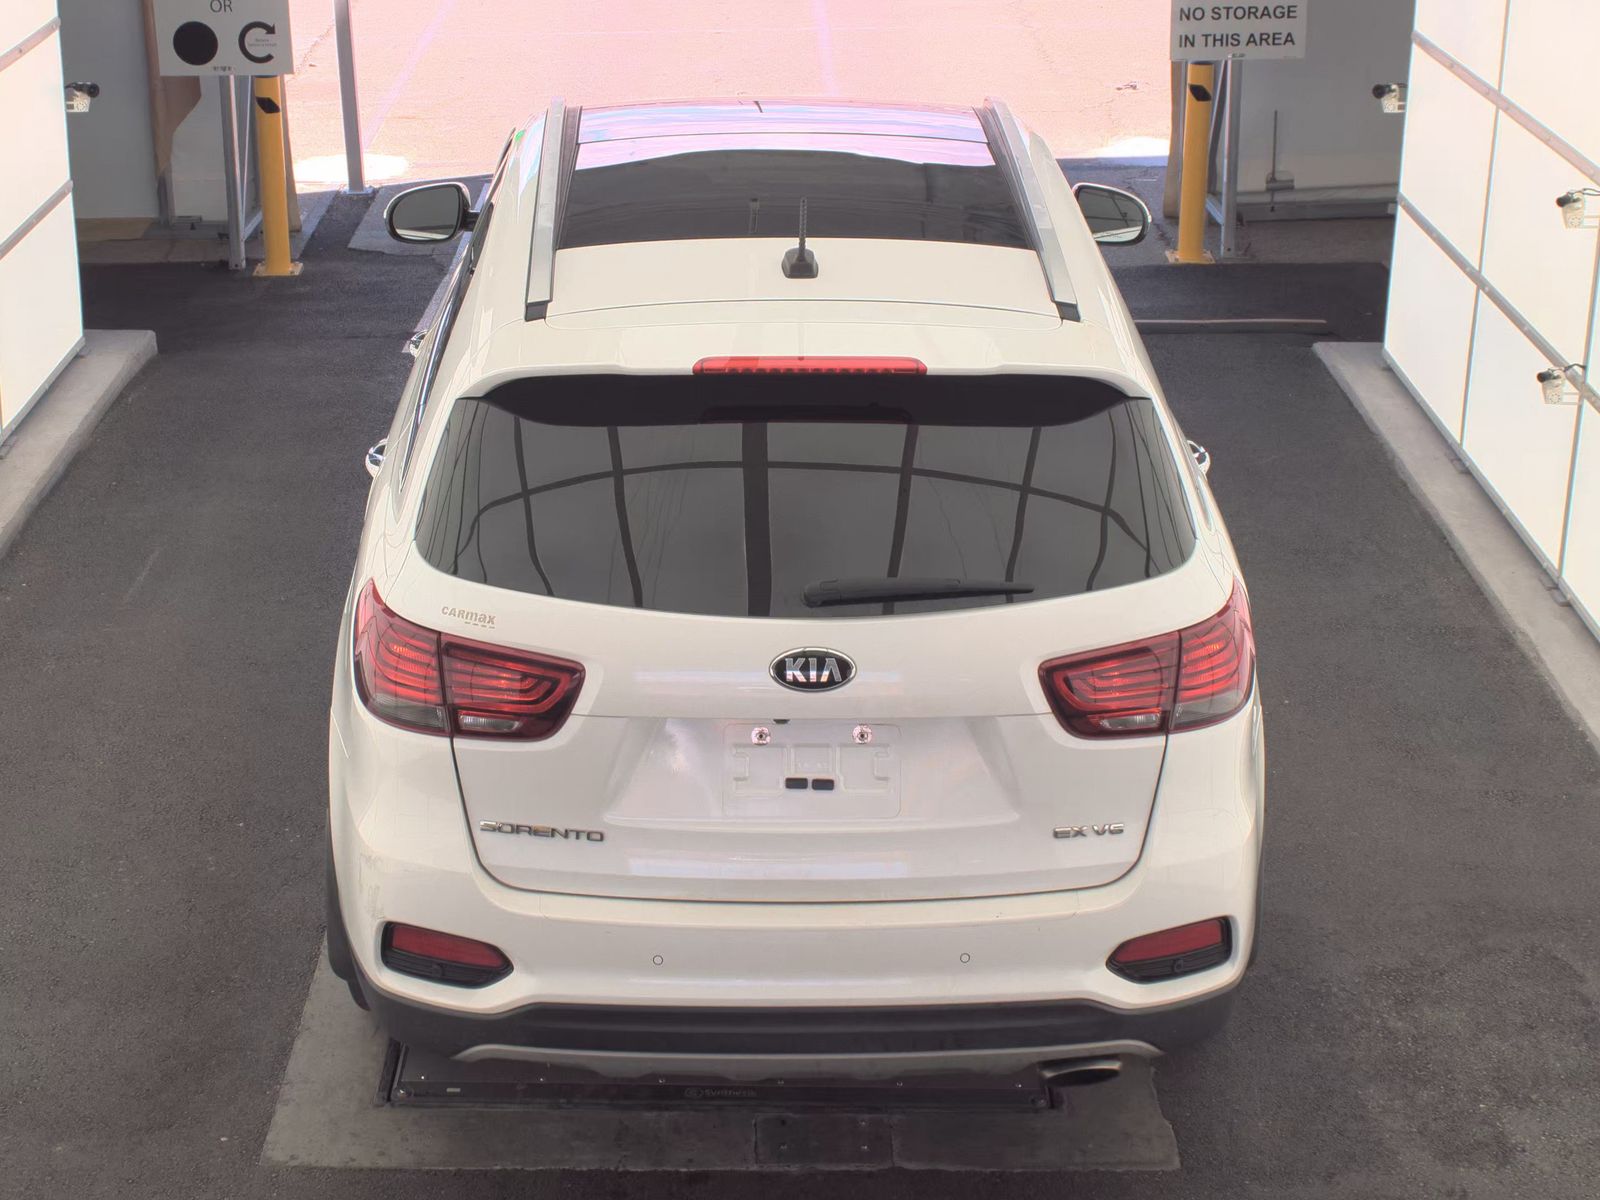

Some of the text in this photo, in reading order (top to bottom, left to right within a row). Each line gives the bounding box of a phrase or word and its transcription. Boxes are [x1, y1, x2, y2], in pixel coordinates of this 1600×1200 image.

[210, 0, 233, 13] OR
[1179, 5, 1298, 21] NO STORAGE
[1179, 32, 1296, 48] IN THIS AREA
[785, 657, 842, 682] KIA
[480, 820, 604, 842] SORENTO
[1053, 823, 1124, 839] EX V6
